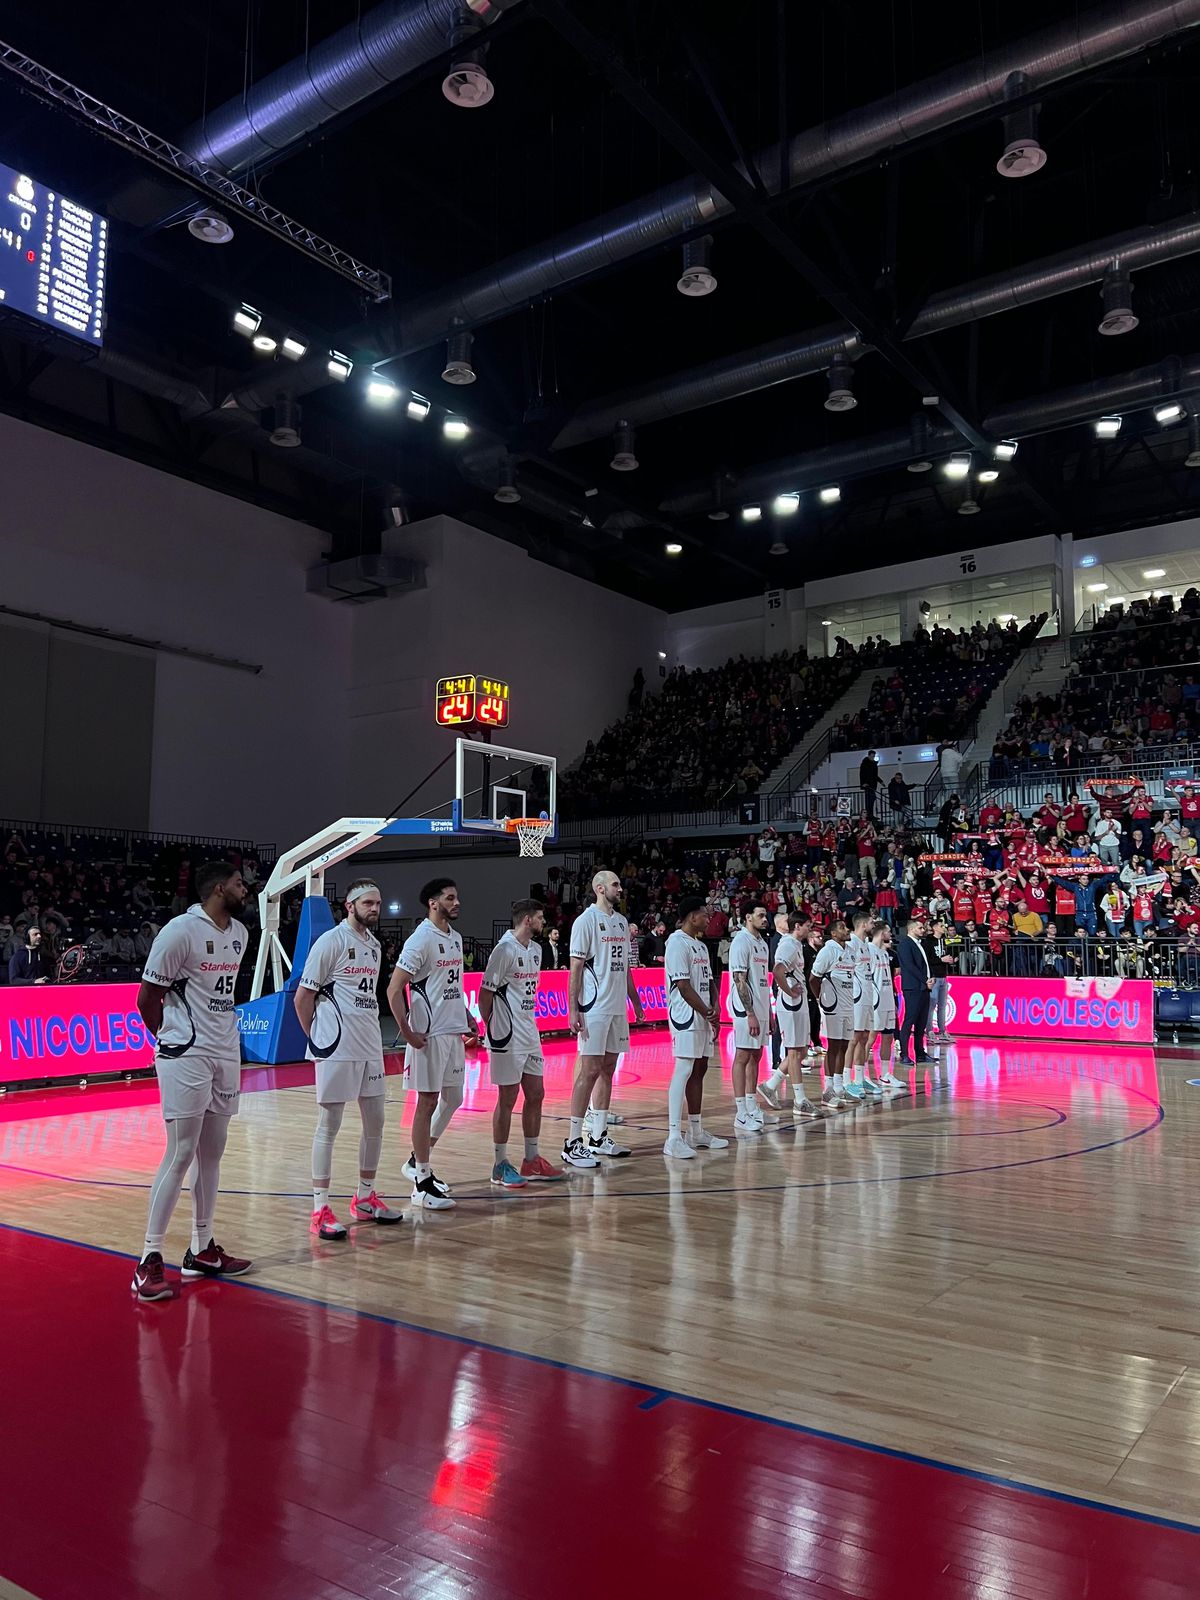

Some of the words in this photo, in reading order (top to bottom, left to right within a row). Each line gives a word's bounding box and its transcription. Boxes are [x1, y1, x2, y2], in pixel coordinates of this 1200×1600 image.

[20, 212, 31, 231] 0
[959, 561, 977, 574] 16
[767, 598, 781, 609] 15
[443, 695, 468, 720] 24
[480, 698, 503, 721] 24
[745, 809, 752, 820] 1
[611, 945, 623, 958] 22
[447, 968, 460, 984] 34
[214, 975, 234, 995] 45
[358, 977, 374, 994] 44
[525, 980, 537, 995] 33
[967, 992, 999, 1023] 24
[1003, 996, 1140, 1028] NICOLESCU
